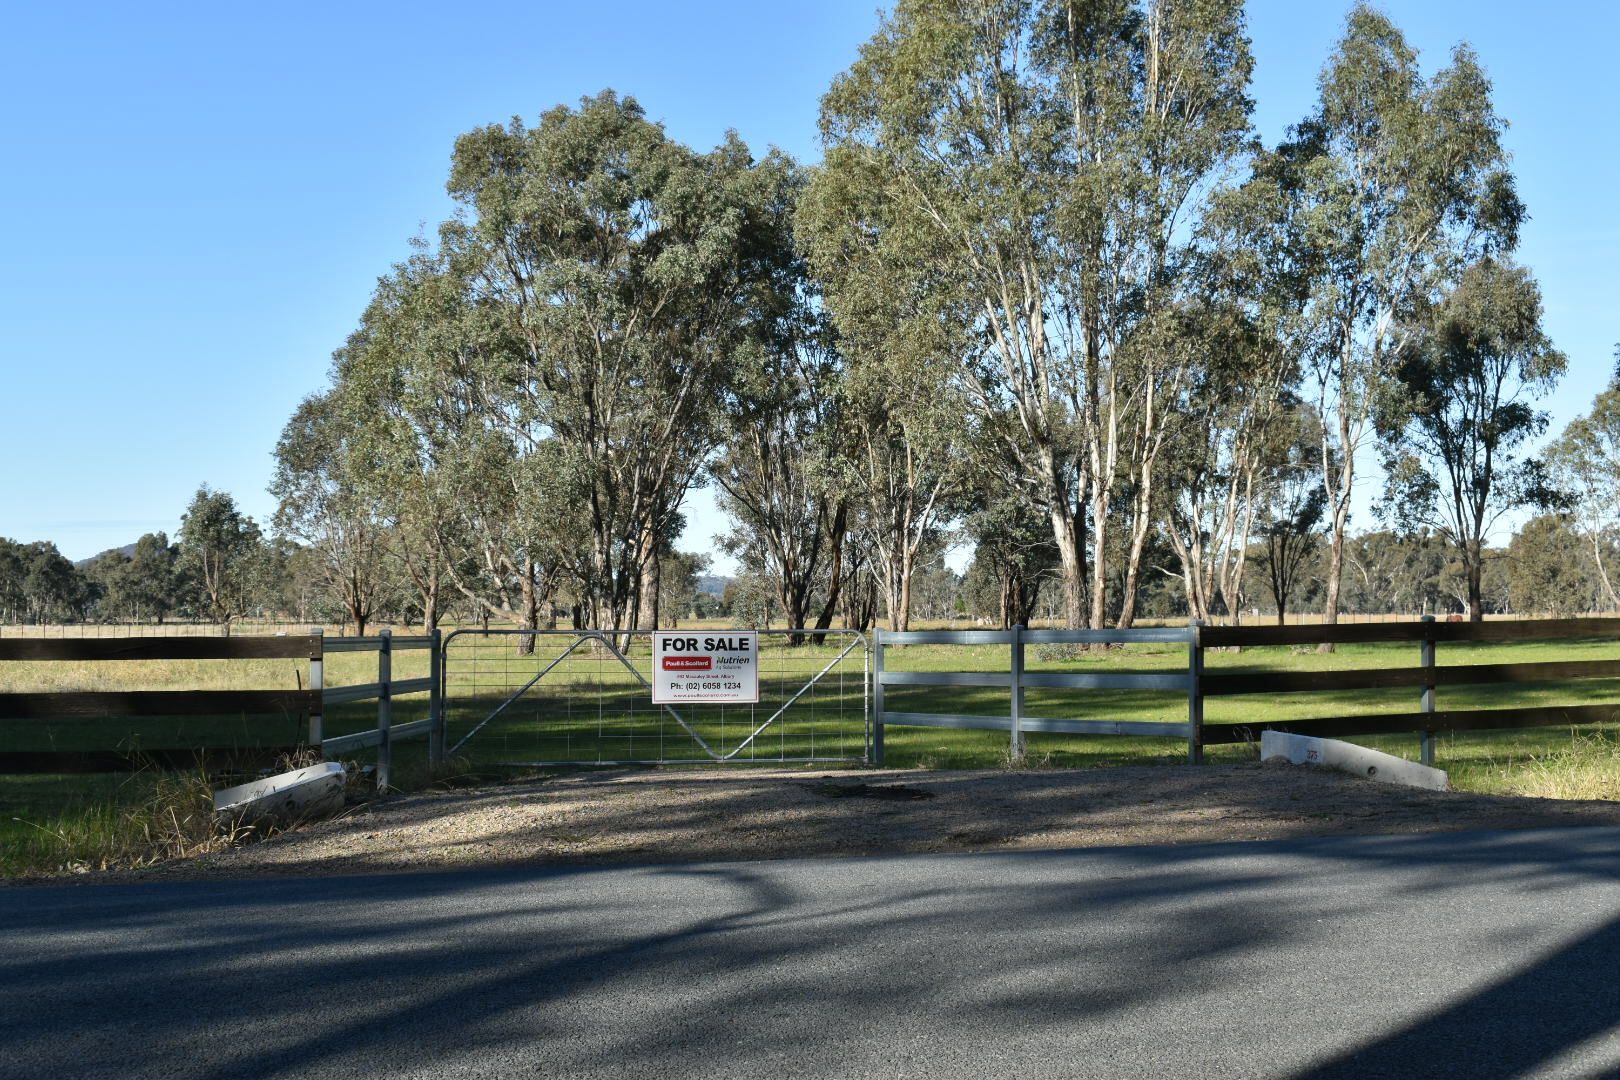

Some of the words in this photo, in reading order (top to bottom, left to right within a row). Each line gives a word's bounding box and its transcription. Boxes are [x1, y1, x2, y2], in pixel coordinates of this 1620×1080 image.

[662, 638, 698, 651] FOR
[704, 638, 749, 651] SALE
[717, 656, 750, 664] Nutrien
[686, 682, 700, 691] (02)
